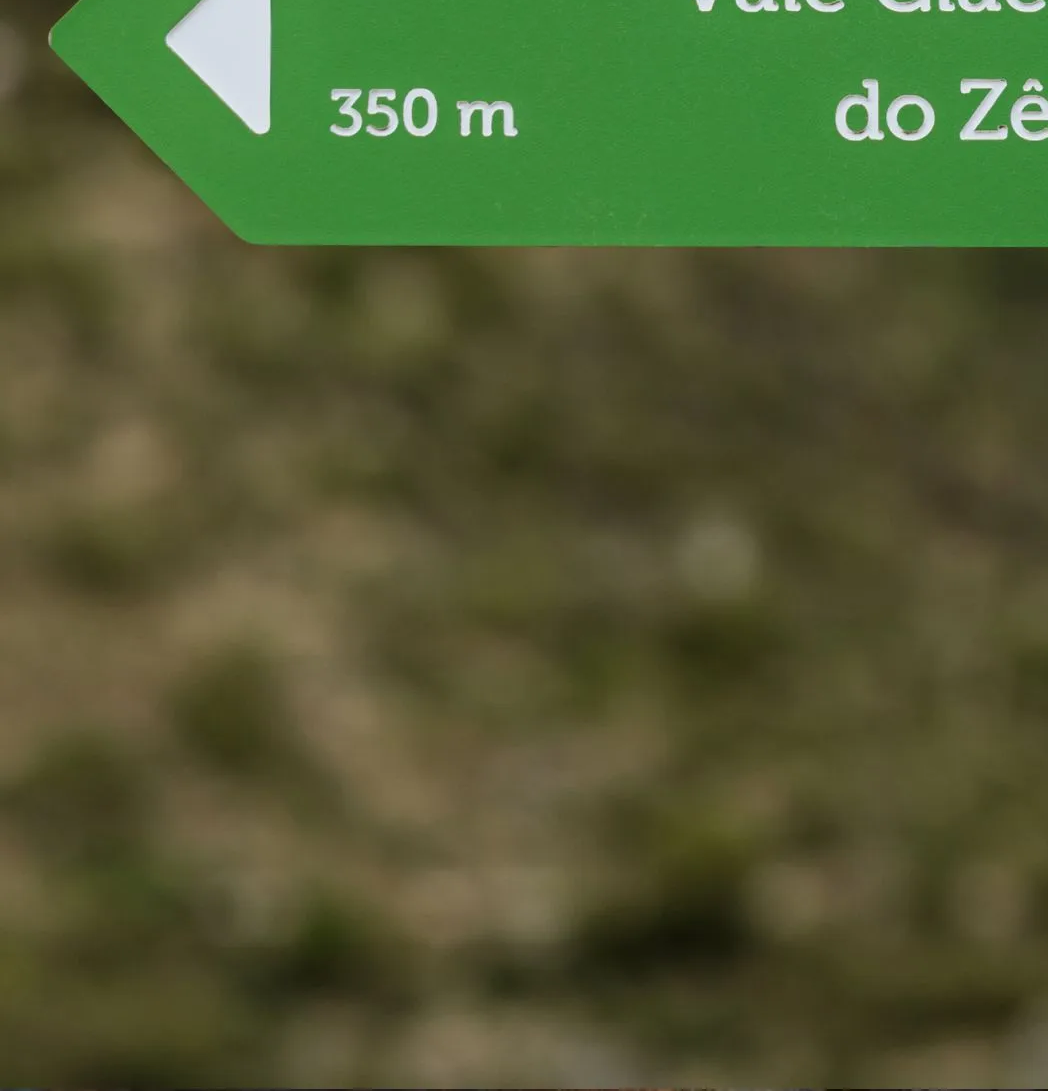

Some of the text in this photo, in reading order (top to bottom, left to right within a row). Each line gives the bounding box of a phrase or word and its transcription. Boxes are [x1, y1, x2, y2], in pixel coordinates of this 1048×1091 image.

[329, 88, 519, 138] 350 m
[834, 79, 936, 141] do
